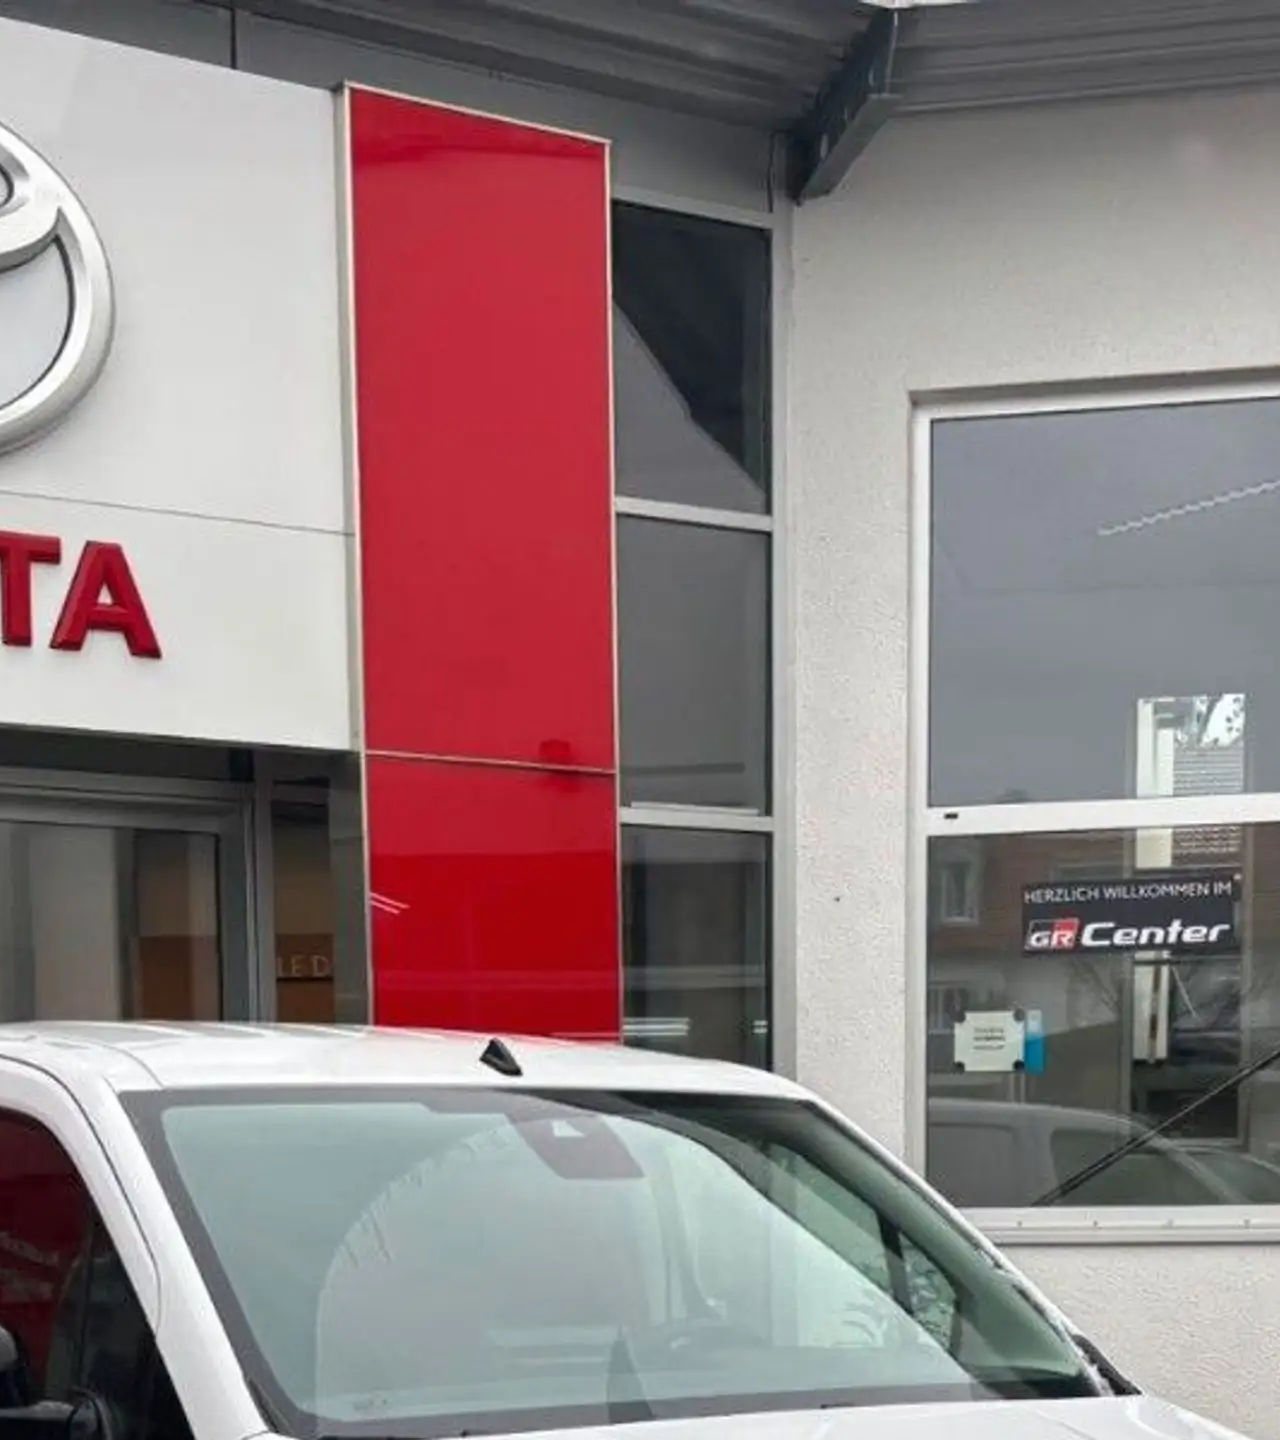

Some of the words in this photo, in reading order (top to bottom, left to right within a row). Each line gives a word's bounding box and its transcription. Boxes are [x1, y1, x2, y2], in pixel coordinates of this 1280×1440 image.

[1024, 886, 1100, 904] HERZLICH
[1103, 882, 1210, 900] WILLKOMMEN
[1213, 881, 1233, 897] IM
[1028, 926, 1075, 948] GR
[1081, 918, 1231, 948] Center
